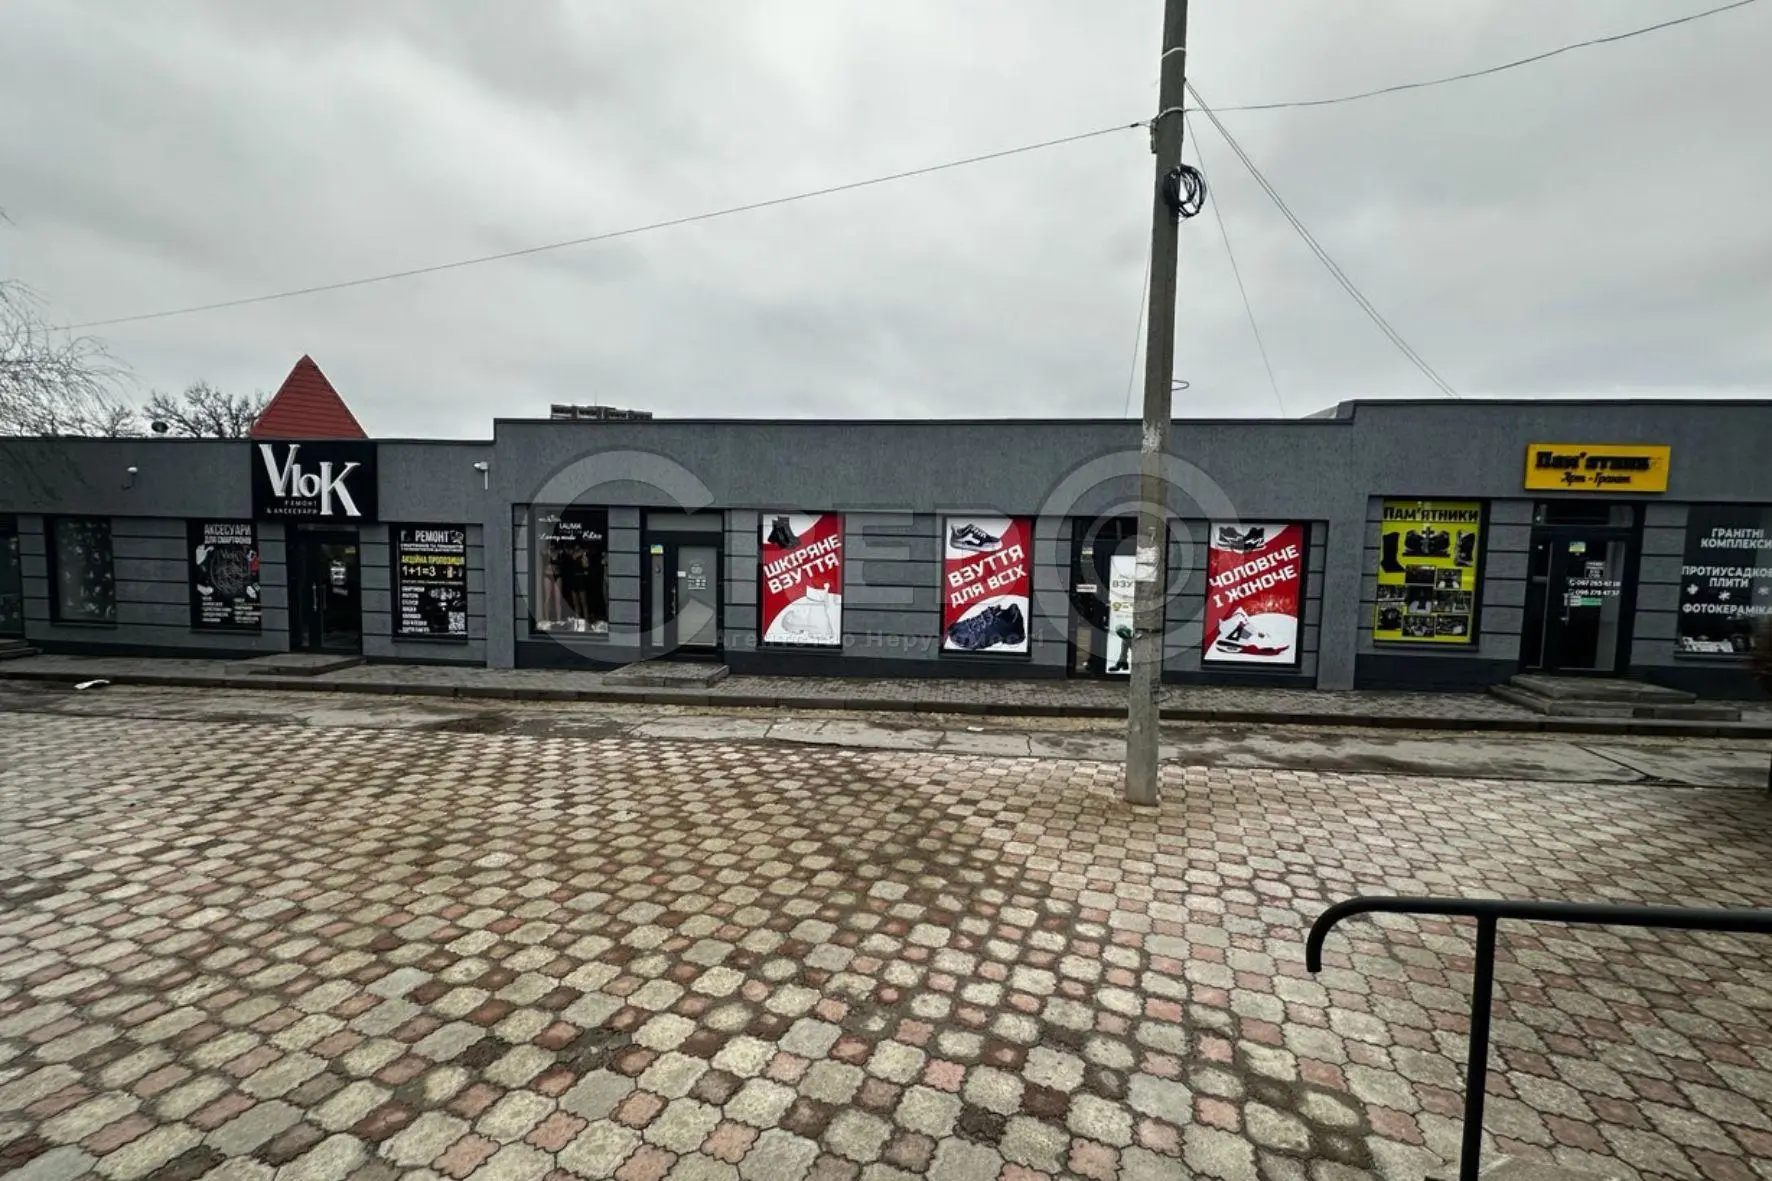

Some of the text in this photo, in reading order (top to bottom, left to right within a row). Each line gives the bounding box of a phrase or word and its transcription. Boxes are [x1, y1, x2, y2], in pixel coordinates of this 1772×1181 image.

[415, 530, 448, 543] РЕМОНТ
[764, 534, 841, 579] ШКІРЯНЕ
[402, 566, 437, 577] 1+1=3
[768, 552, 839, 594] ВЗУТТЯ
[948, 544, 1024, 588] ВЗУТТЯ
[950, 564, 1027, 608] ДЛЯ ВСІХ
[1209, 545, 1299, 588] ЧОЛОВІЧЕ
[1213, 565, 1297, 608] І ЖІНОЧЕ
[1709, 578, 1749, 588] ПЛИТИ
